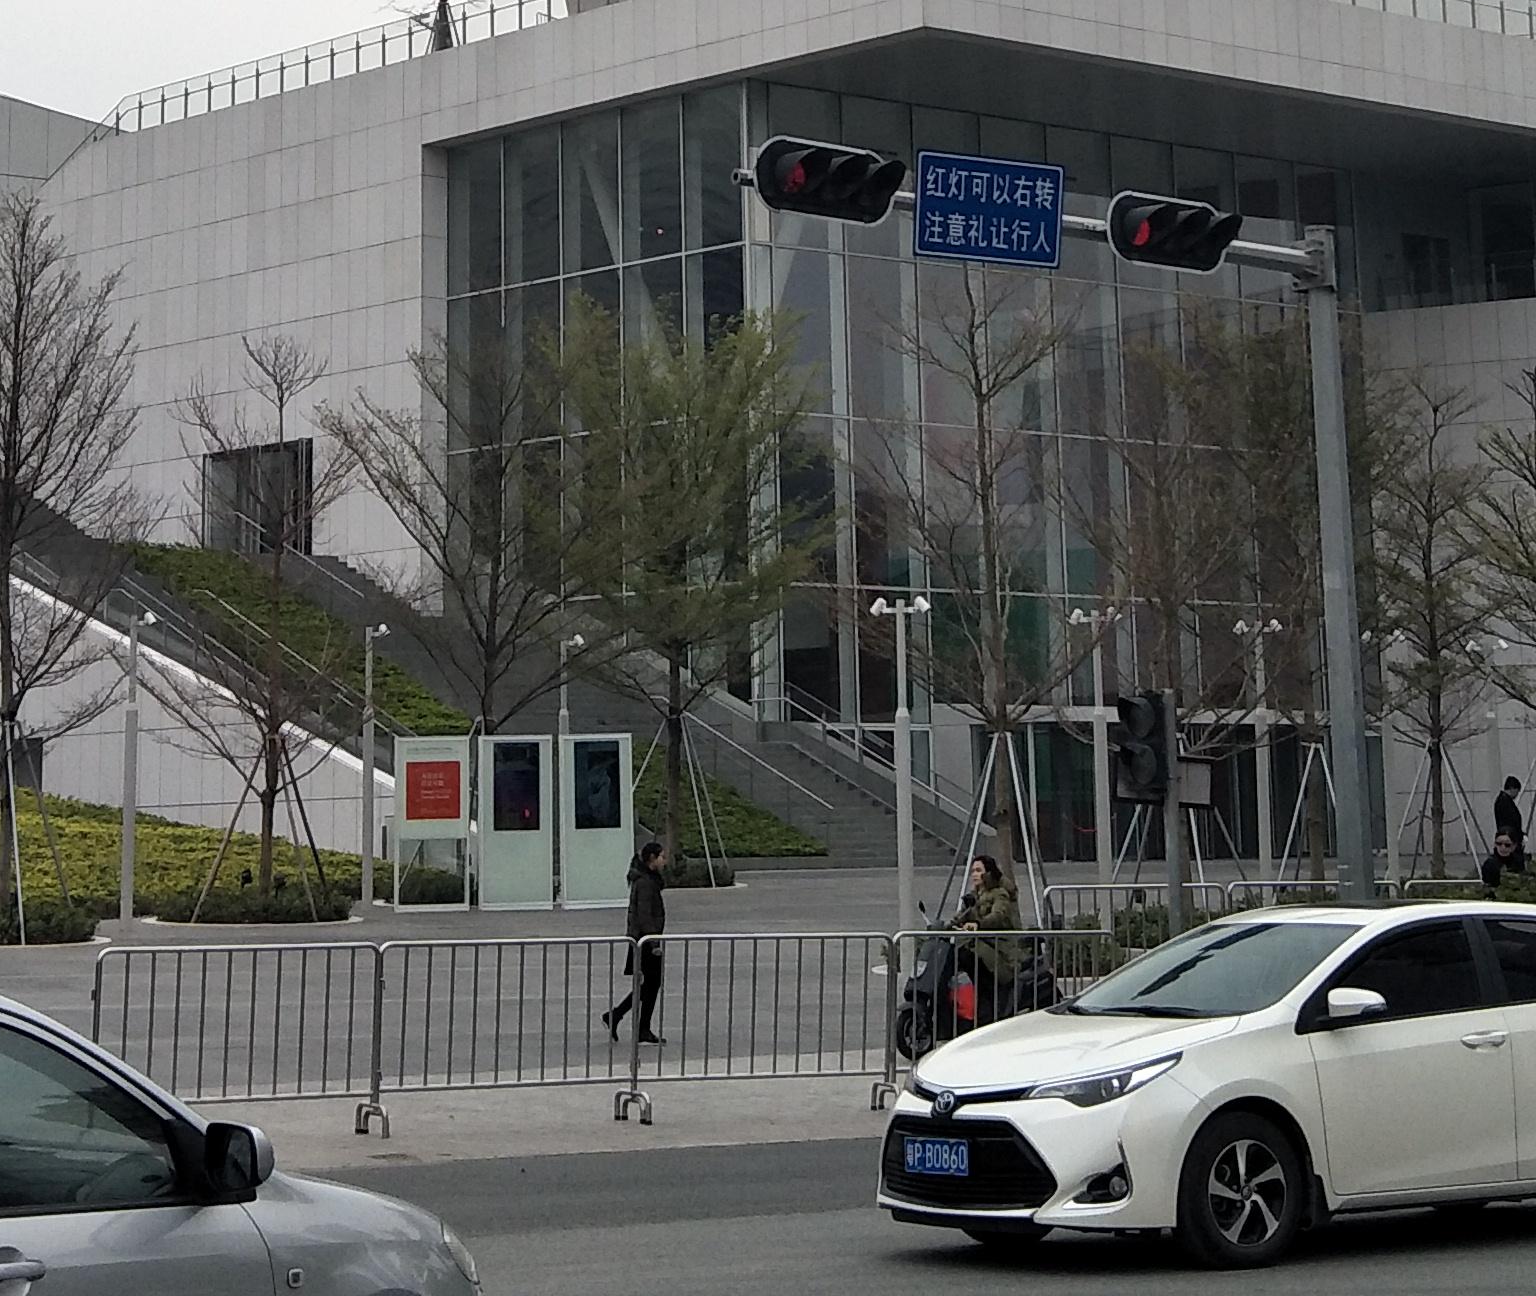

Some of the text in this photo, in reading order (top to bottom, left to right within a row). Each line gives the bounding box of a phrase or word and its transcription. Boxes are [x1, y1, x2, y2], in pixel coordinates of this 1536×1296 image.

[925, 164, 1056, 211] 红灯可以右转
[923, 210, 1052, 254] 注意礼让行人
